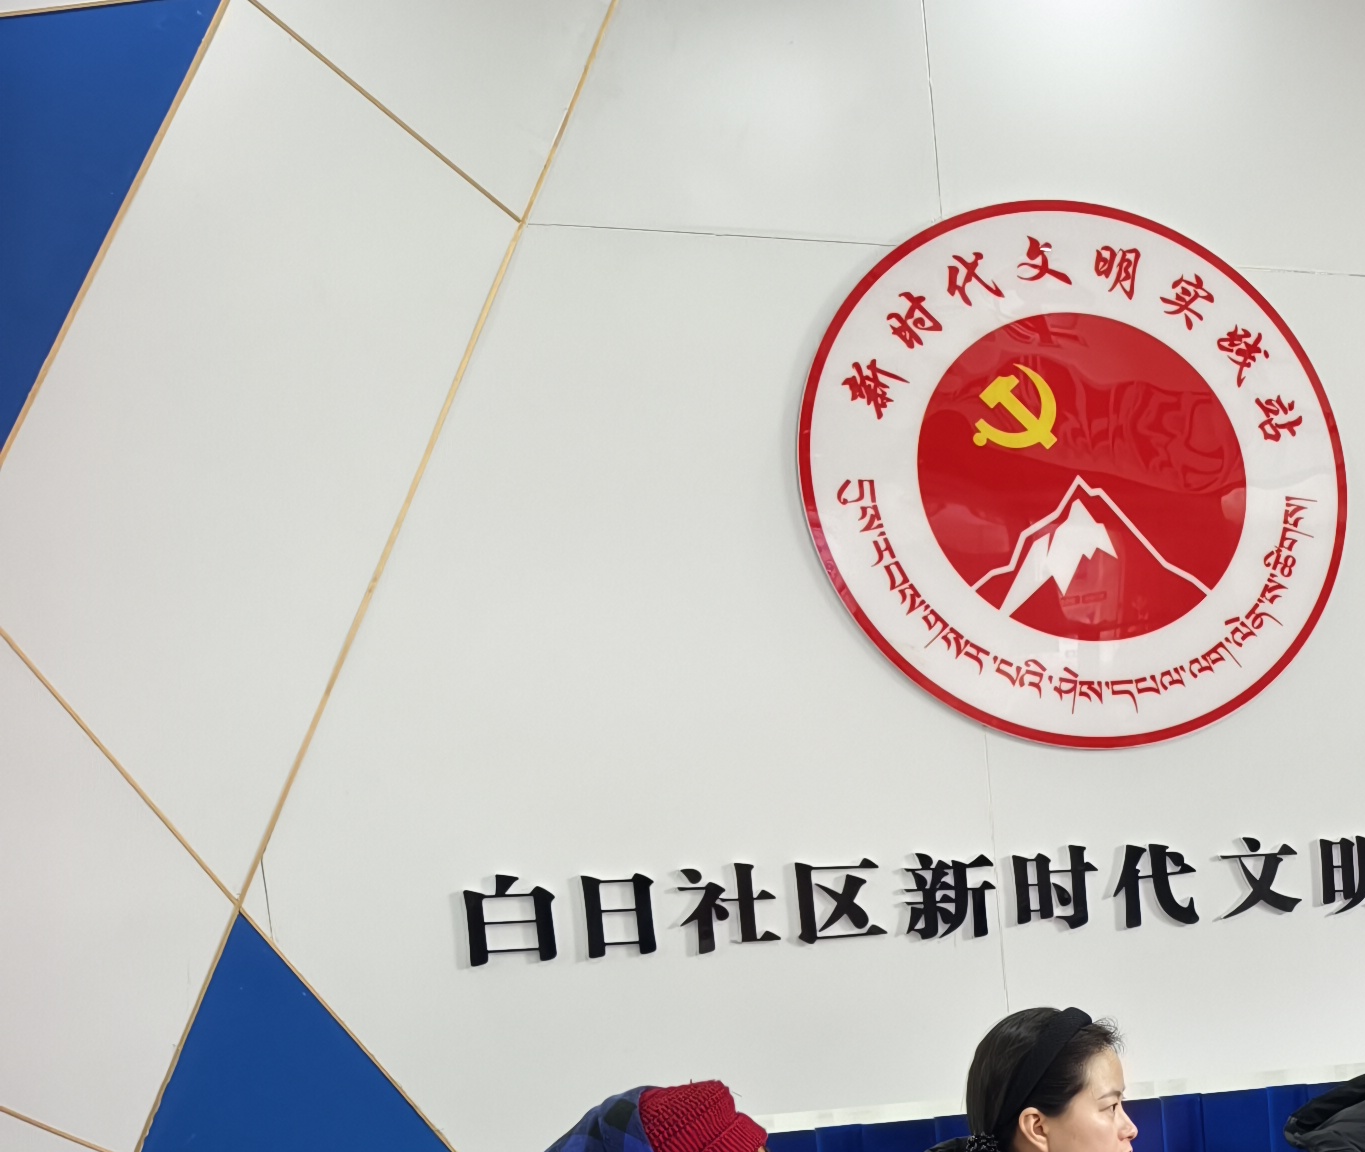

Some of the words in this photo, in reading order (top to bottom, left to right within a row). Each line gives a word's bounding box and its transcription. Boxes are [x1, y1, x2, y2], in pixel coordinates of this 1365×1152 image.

[841, 235, 1303, 443] 新时代文明实践站
